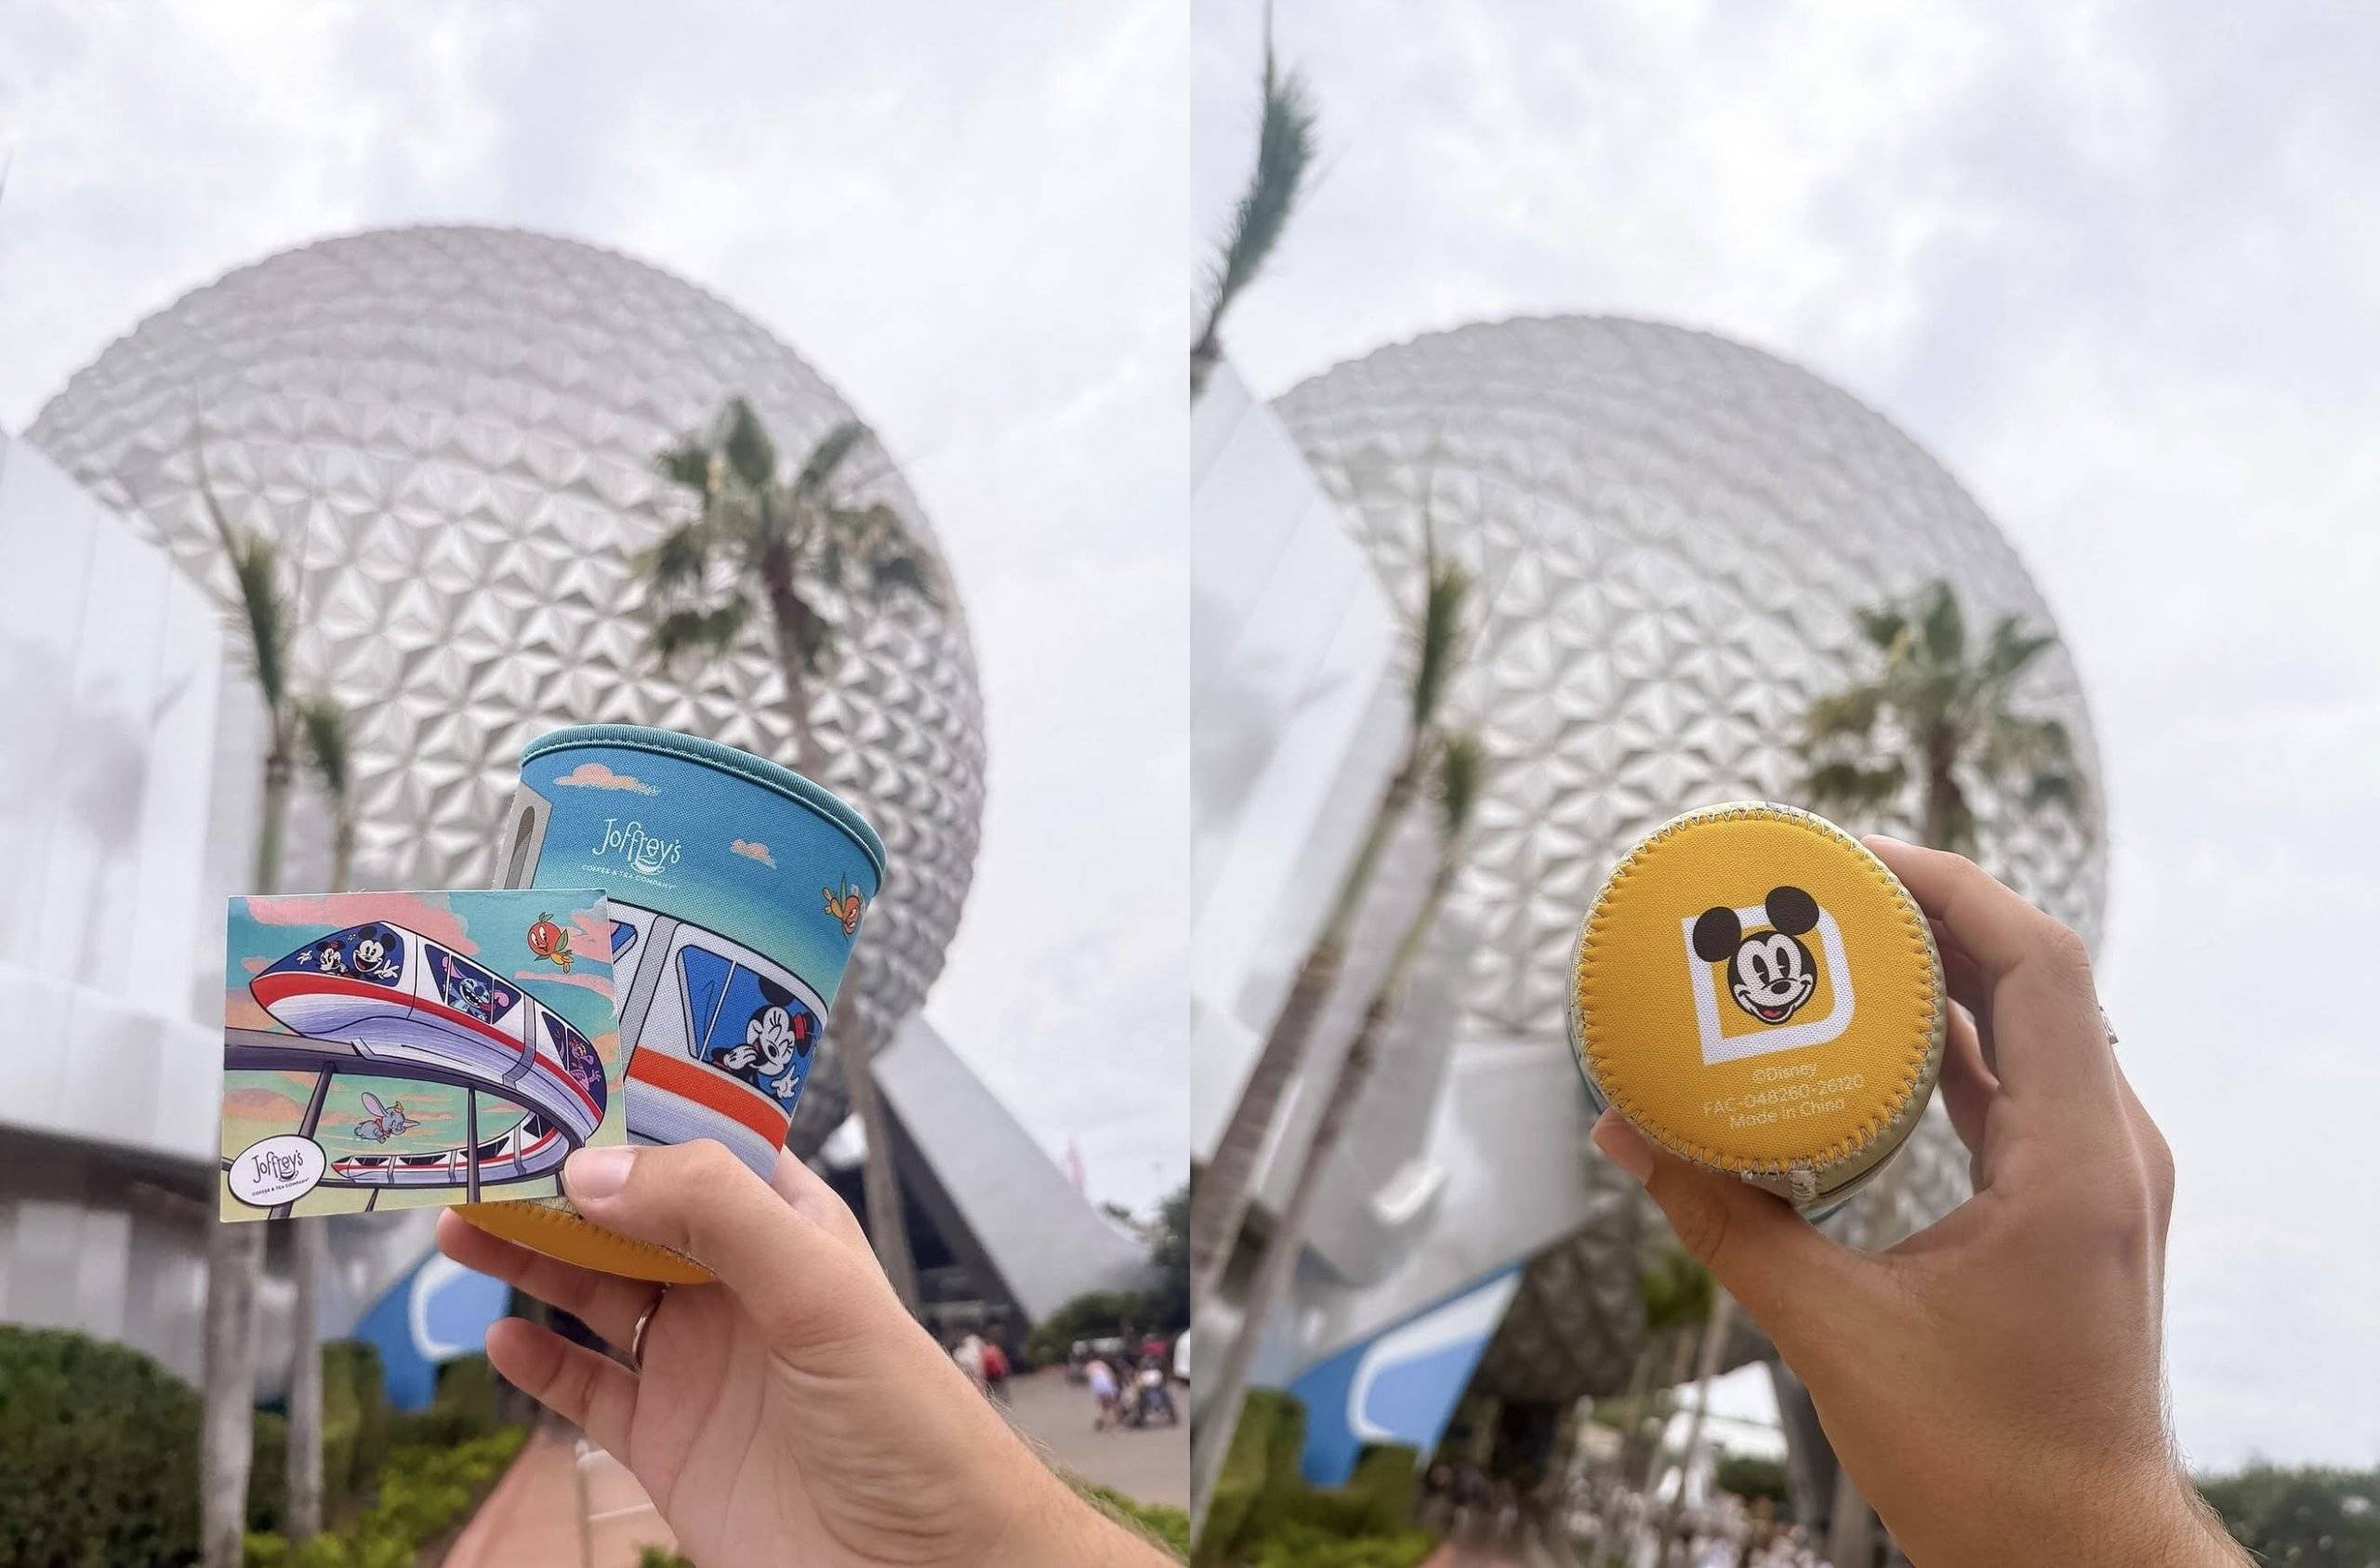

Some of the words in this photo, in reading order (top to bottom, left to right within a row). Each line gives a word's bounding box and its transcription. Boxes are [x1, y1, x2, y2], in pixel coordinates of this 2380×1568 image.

[592, 818, 681, 866] Joffrey's
[1730, 1112, 1778, 1129] Made
[1782, 1107, 1797, 1118] in
[1801, 1098, 1845, 1116] China
[252, 1150, 304, 1183] Joffrey's
